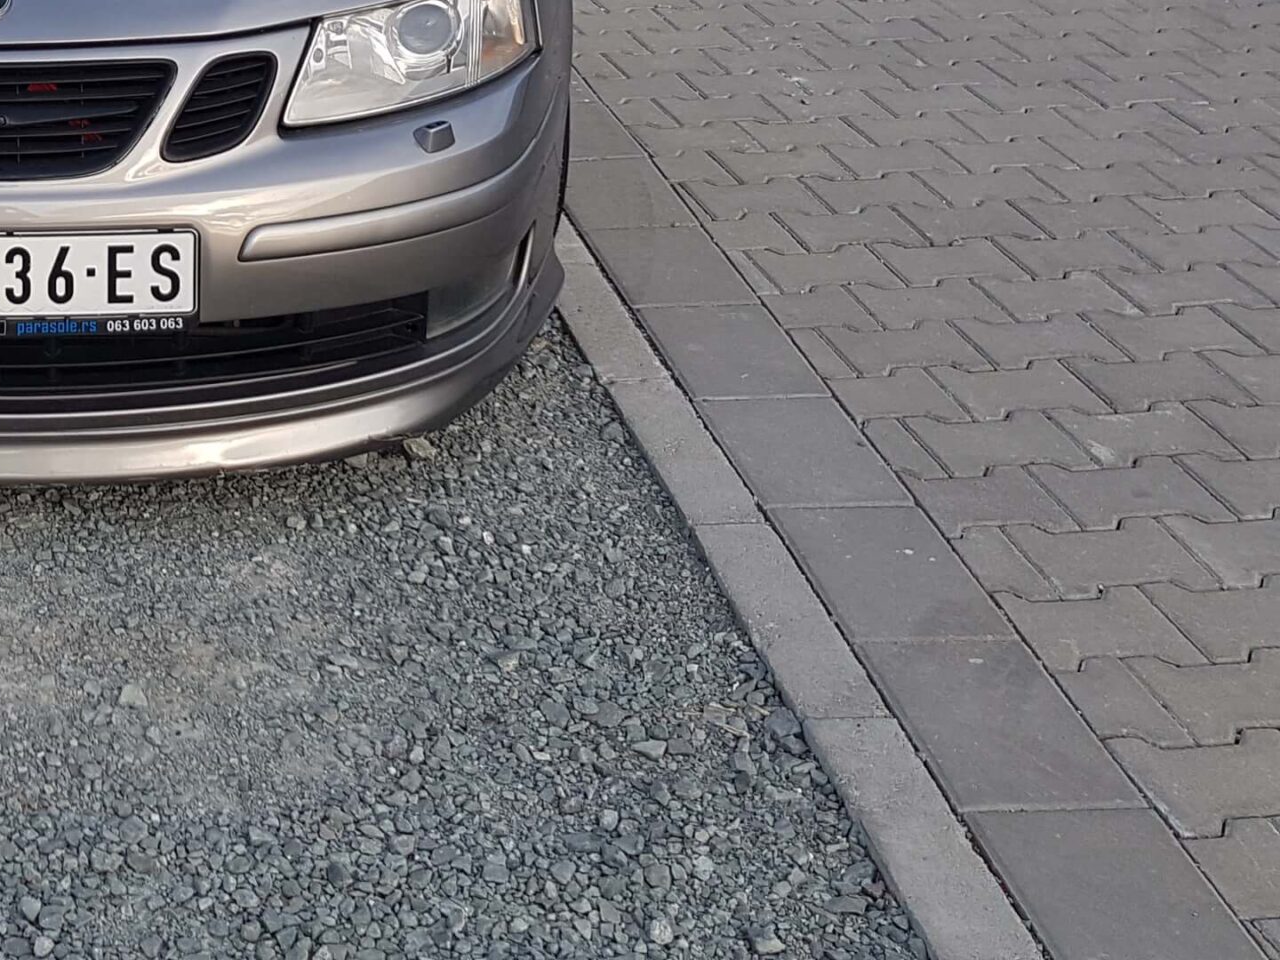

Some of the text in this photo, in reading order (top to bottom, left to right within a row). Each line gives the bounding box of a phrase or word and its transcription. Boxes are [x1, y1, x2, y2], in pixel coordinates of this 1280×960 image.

[16, 317, 183, 335] parasole.rs 063 603 063
